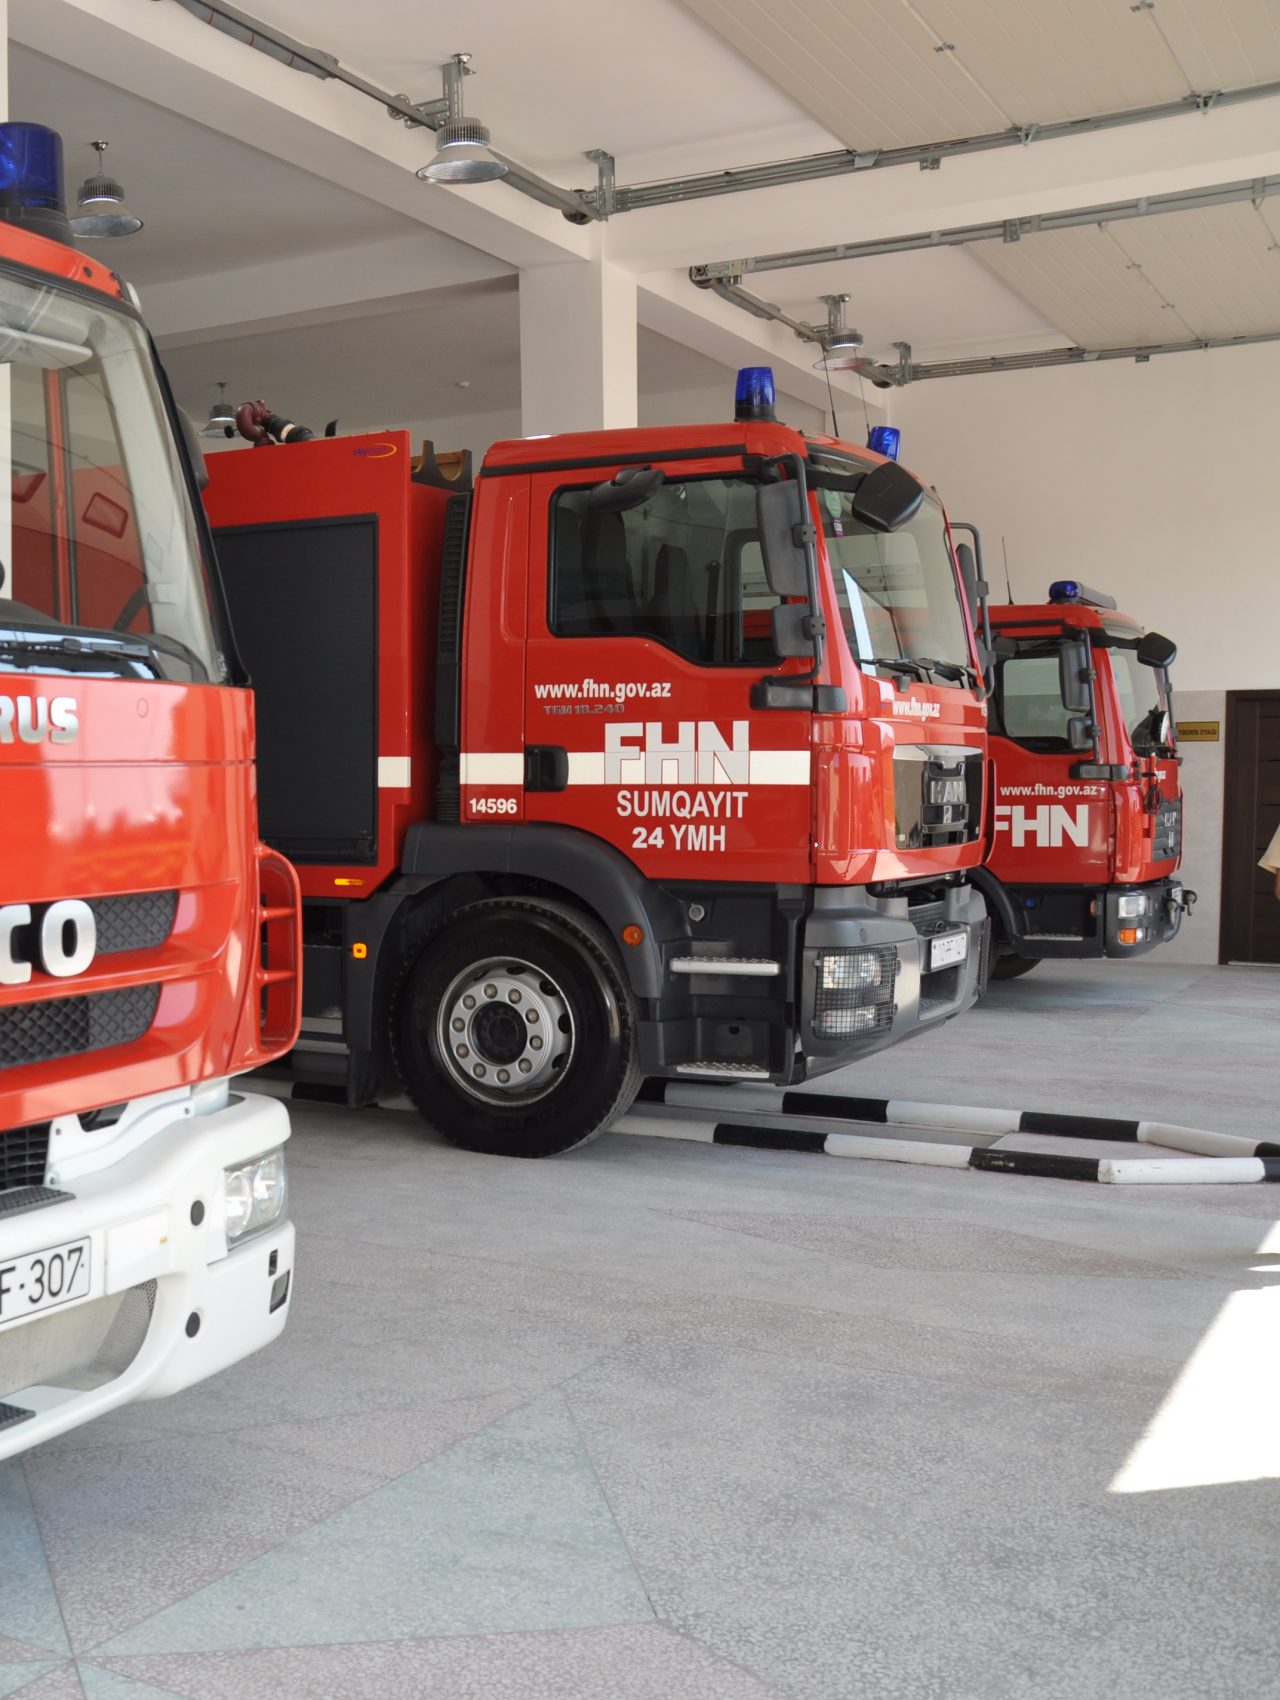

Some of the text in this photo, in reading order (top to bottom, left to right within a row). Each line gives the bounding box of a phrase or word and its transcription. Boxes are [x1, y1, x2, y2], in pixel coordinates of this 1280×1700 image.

[534, 678, 672, 703] www.fhn.gov.az
[604, 720, 750, 785] FHN
[1000, 783, 1098, 799] www.fhn.gov.az
[469, 798, 518, 815] 14596
[616, 790, 748, 819] SUMQAYIT
[631, 825, 726, 852] 24 YMH
